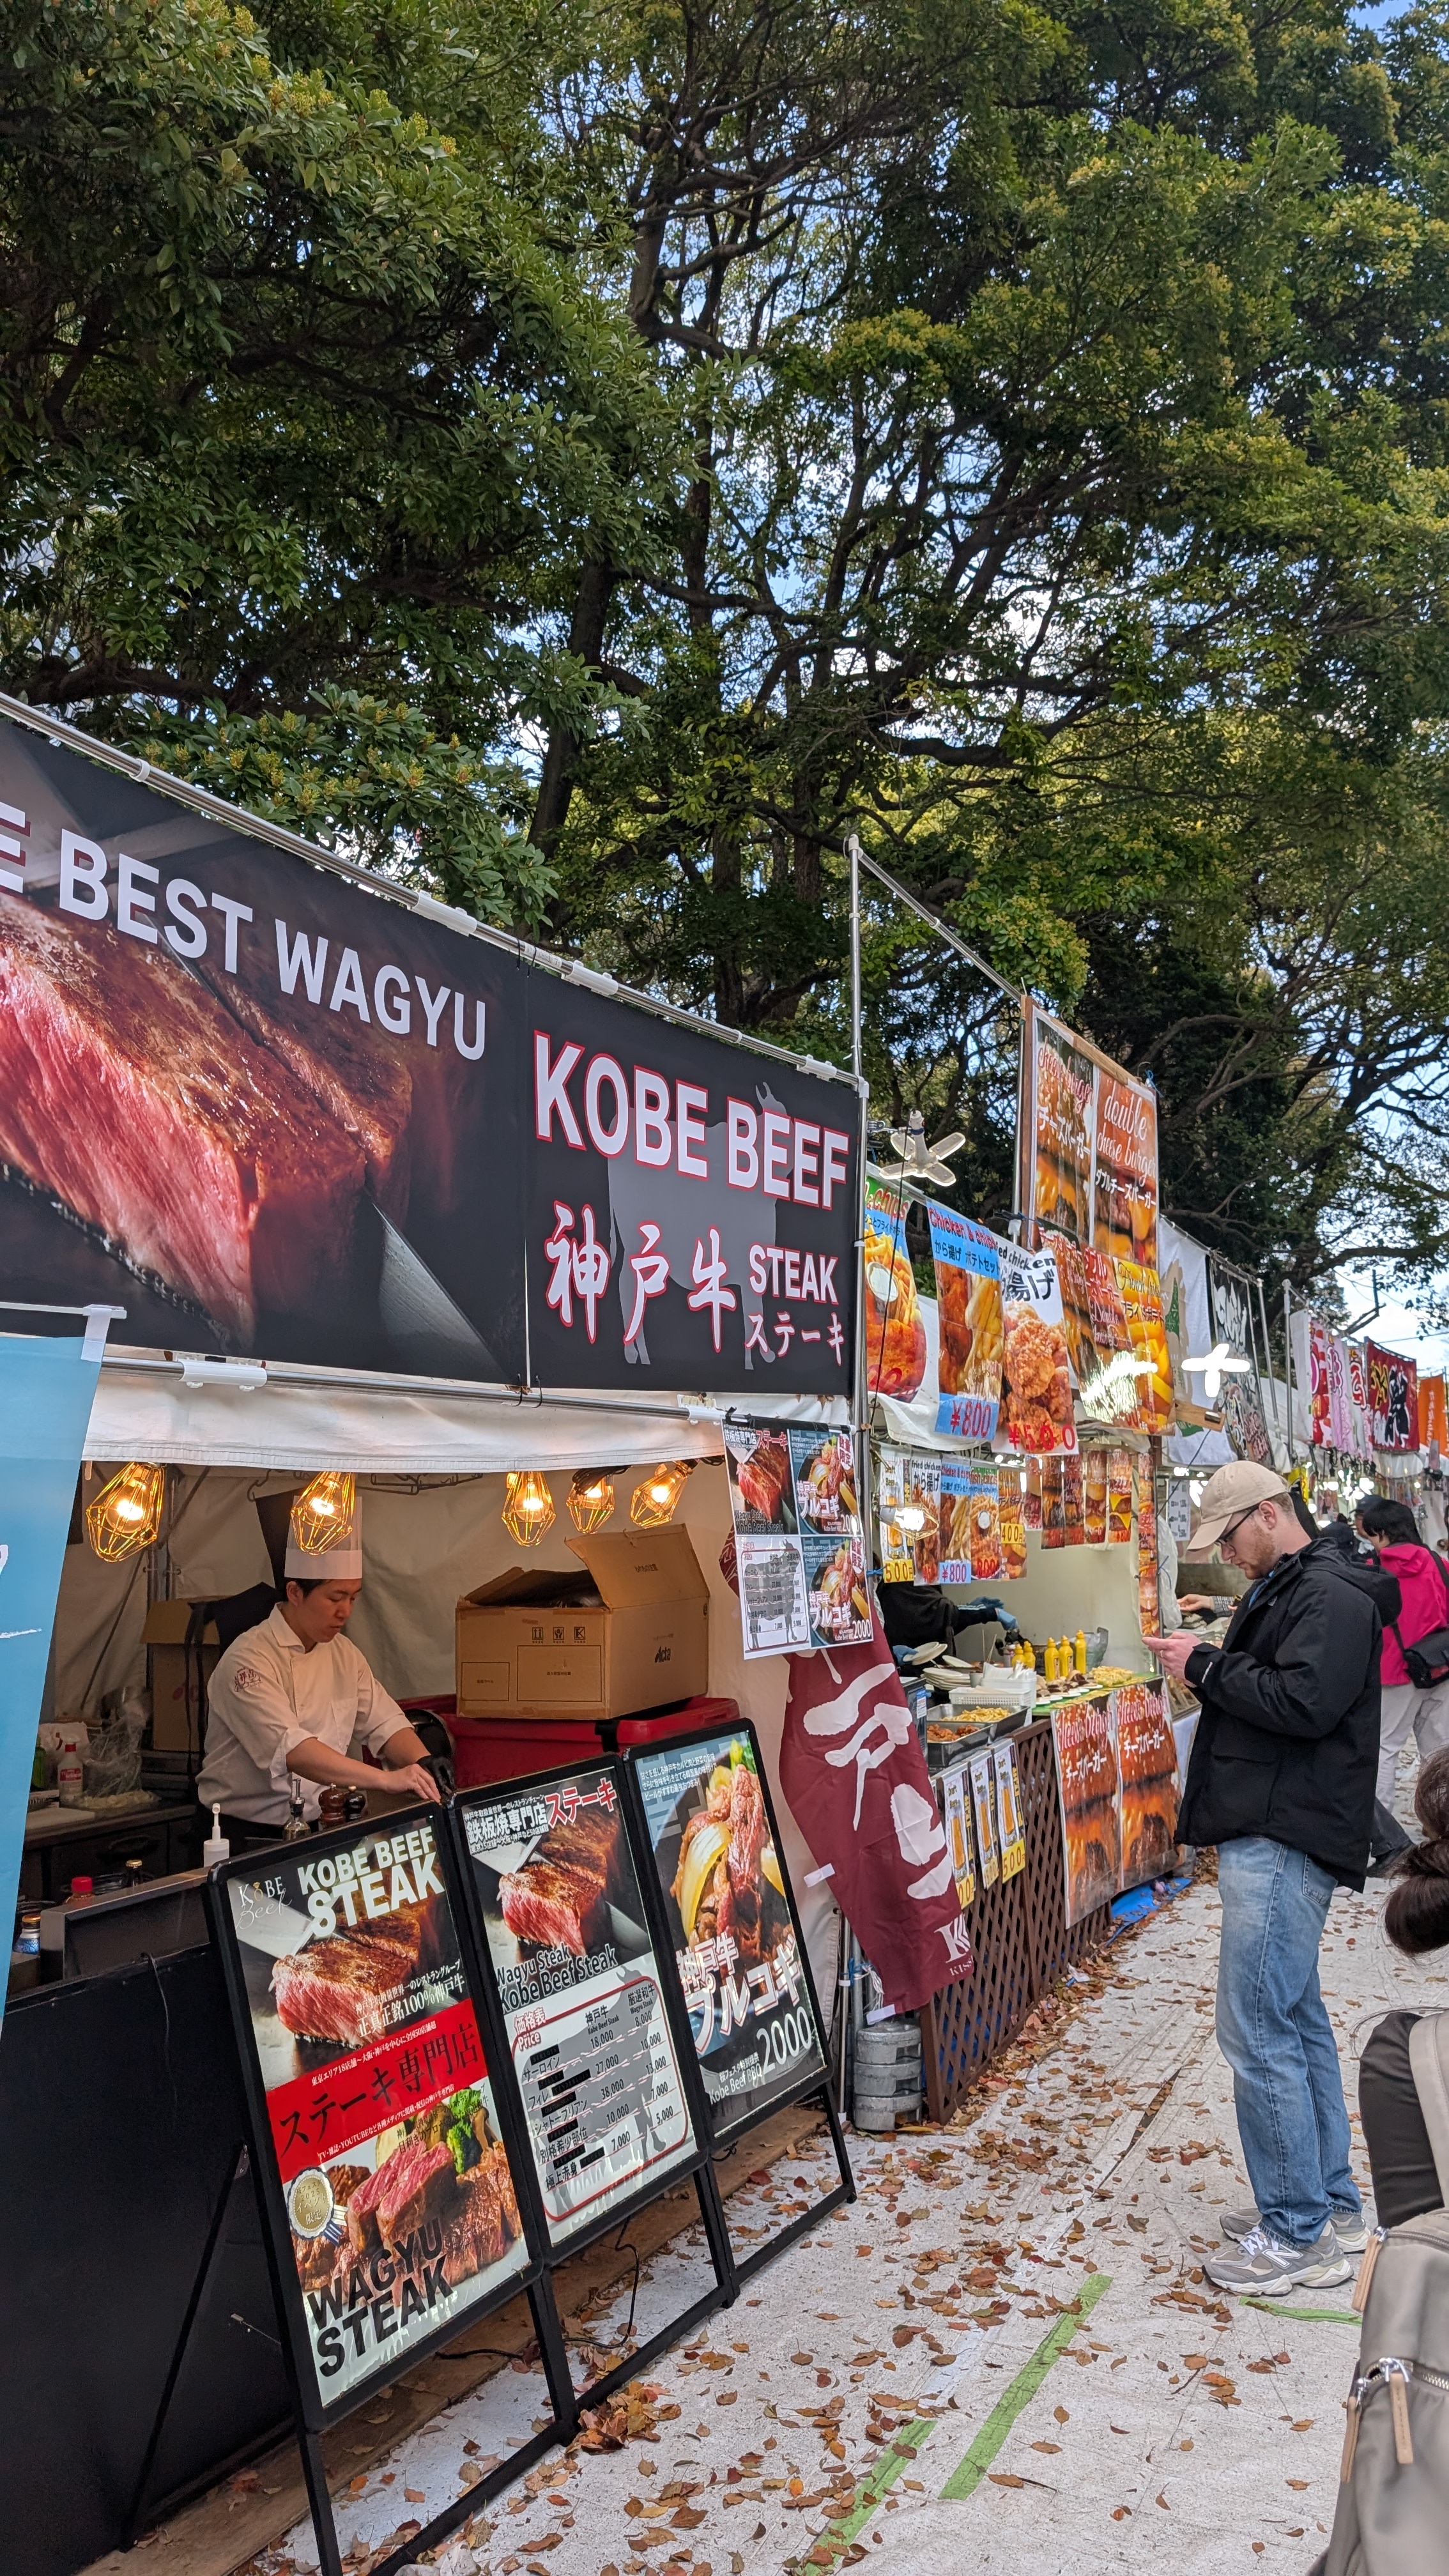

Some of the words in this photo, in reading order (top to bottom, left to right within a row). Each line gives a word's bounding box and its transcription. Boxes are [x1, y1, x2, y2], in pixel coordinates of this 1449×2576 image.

[59, 829, 254, 972] BEST
[275, 919, 486, 1061] WAGYU
[534, 1030, 709, 1181] KOBE
[727, 1097, 849, 1209] BEEF
[1104, 1080, 1147, 1141] double
[1039, 1105, 1091, 1160] チーズバーガー
[1097, 1122, 1123, 1162] cheese
[1095, 1168, 1156, 1209] ダブルチーズバーガー
[928, 1206, 967, 1240] Chicken
[545, 1200, 737, 1353] 神戸牛
[749, 1243, 839, 1305] STEAK
[935, 1239, 962, 1261] から揚げ
[965, 1250, 1000, 1276] ポテトセット
[1008, 1252, 1056, 1271] chicken
[745, 1310, 845, 1366] ステーキ
[950, 1400, 992, 1438] ¥800
[1007, 1423, 1076, 1453] ¥500
[756, 1430, 788, 1452] ステーキ
[912, 1460, 923, 1469] fried
[924, 1461, 941, 1471] chicken
[914, 1471, 940, 1493] から揚げ
[798, 1491, 839, 1520] プルコギ
[942, 1563, 967, 1582] ¥800
[809, 1601, 852, 1632] プルコギ
[852, 1619, 871, 1639] 2000
[1124, 1728, 1165, 1759] チーズバーガー
[1066, 1749, 1107, 1788] チーズバーガー
[545, 1777, 618, 1828] ステーキ
[466, 1802, 548, 1845] 鉄板焼専門店
[297, 1847, 371, 1895] KOBE
[374, 1826, 433, 1869] BEEF
[236, 1887, 293, 1929] Beef
[238, 1876, 285, 1907] KOBE
[307, 1851, 445, 1938] STEAK
[537, 1942, 571, 1970] Steak
[675, 1931, 739, 1994] 神戸牛
[355, 1959, 461, 2014] 神戸牛取扱量世界一のレストラングループ
[500, 1979, 540, 2013] Kobe
[540, 1959, 576, 1997] Beef
[576, 1943, 618, 1982] Steak
[627, 1982, 656, 2007] 厳選和牛
[684, 1934, 801, 2055] プルコギ
[358, 1973, 465, 2037] 正真正銘100%神戸牛
[514, 2007, 546, 2034] 価格表
[585, 2004, 609, 2026] 神戸牛
[588, 2023, 598, 2035] Kobe
[598, 2020, 608, 2032] Beef
[608, 2014, 620, 2027] Steak
[629, 2004, 643, 2014] Wagyu
[643, 2000, 654, 2009] Steak
[517, 2032, 542, 2051] Price
[523, 2057, 560, 2082] サーロイン
[590, 2029, 614, 2050] 18,000
[634, 2010, 652, 2027] 8,000
[595, 2053, 620, 2074] 27,000
[640, 2032, 661, 2051] 10,000
[756, 2006, 811, 2075] 2000
[709, 2084, 730, 2106] Kobe
[730, 2074, 747, 2093] Beef
[747, 2064, 763, 2083] BBQ
[719, 2051, 760, 2083] 桜フェスタ特別提供
[279, 2023, 479, 2158] ステーキ専門店
[528, 2091, 549, 2110] フィレ
[535, 2099, 588, 2136] シャトーブリアン
[601, 2078, 624, 2100] 38,000
[645, 2055, 666, 2075] 13,000
[539, 2126, 588, 2163] 別格希少部位
[606, 2103, 629, 2124] 10,000
[650, 2082, 668, 2100] 7,000
[545, 2161, 578, 2189] 極上赤身
[611, 2131, 631, 2152] 7,000
[656, 2105, 673, 2125] 5,000
[296, 2193, 327, 2213] イベント
[301, 2188, 320, 2202] 2025
[305, 2209, 322, 2225] 限定
[307, 2217, 442, 2331] WAGYU
[317, 2254, 455, 2377] STEAK
